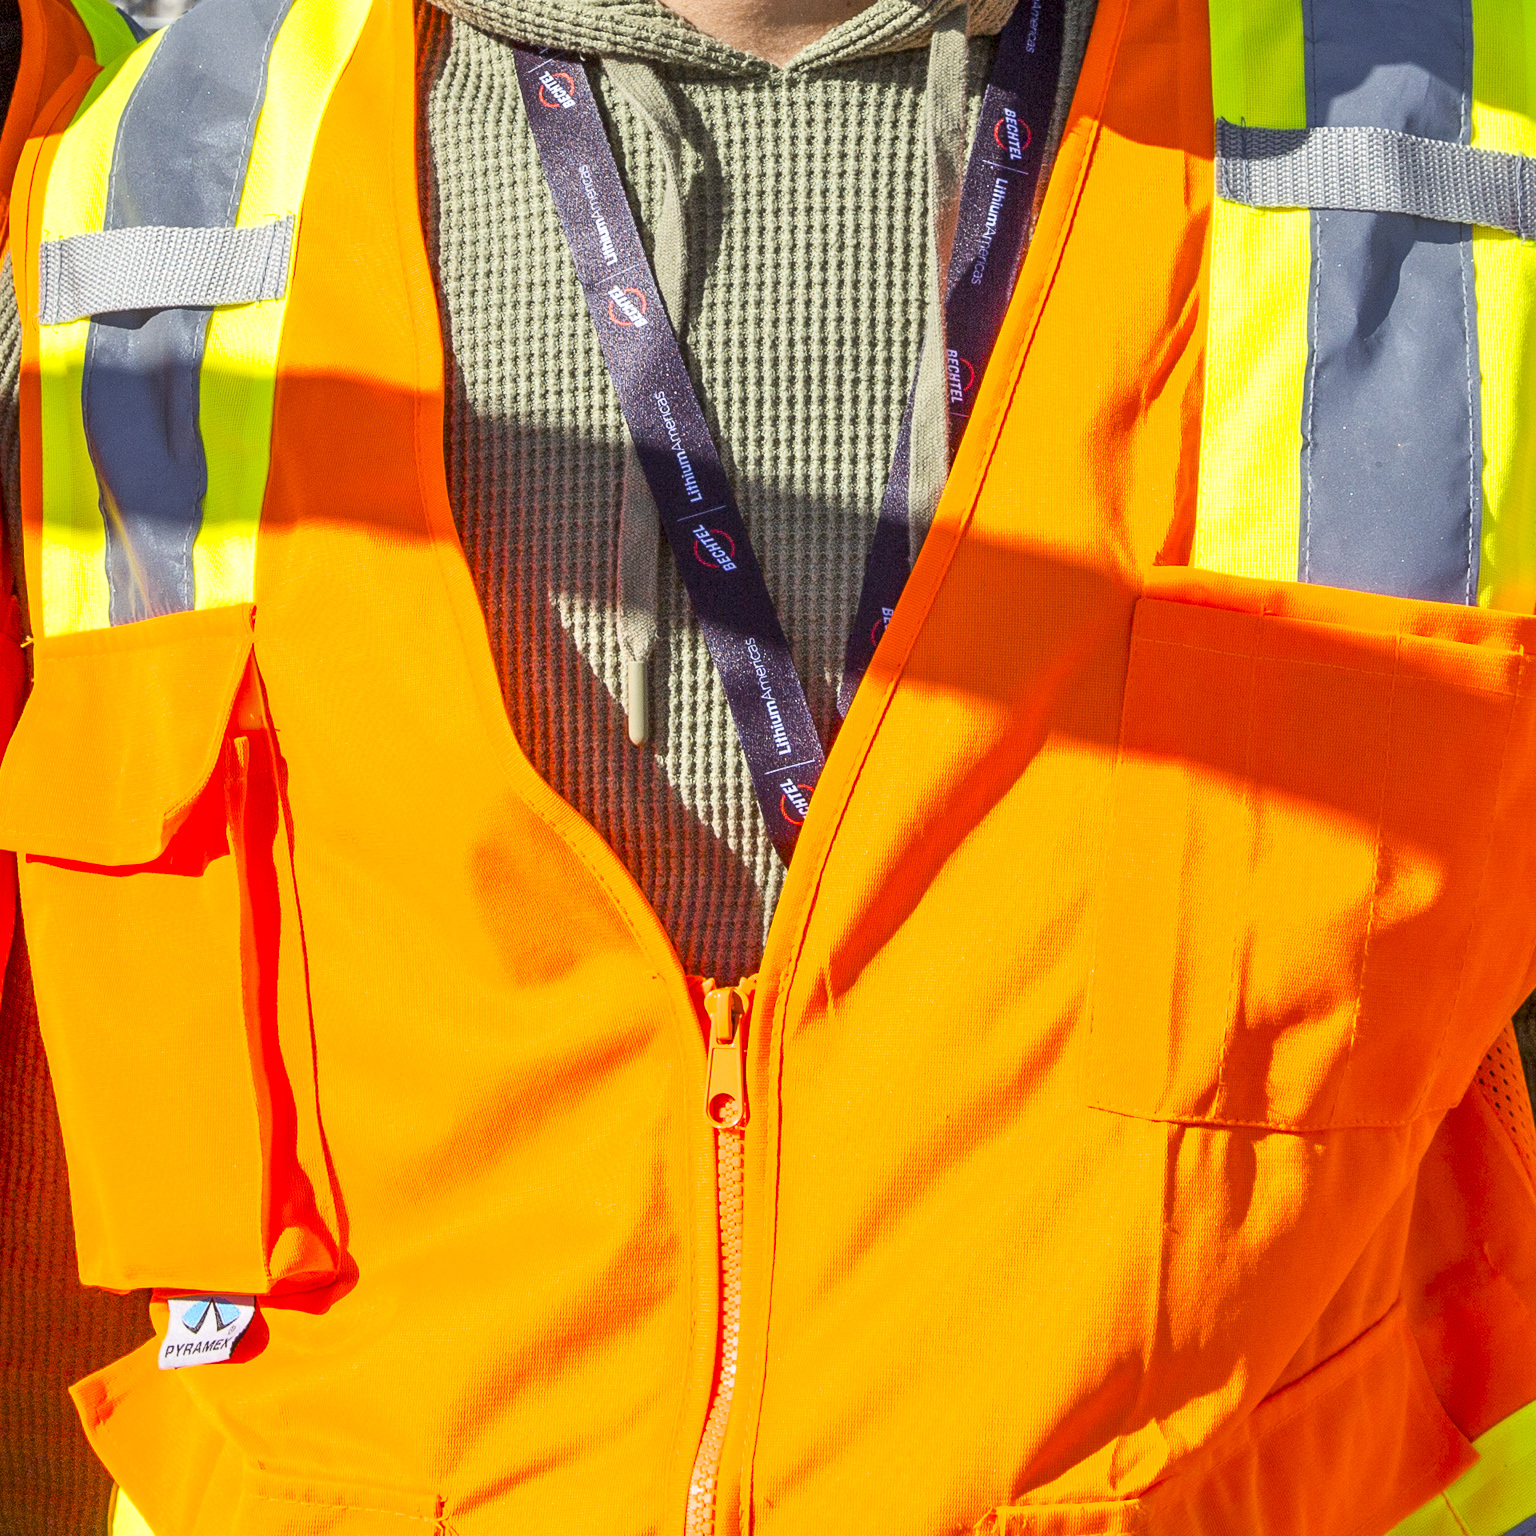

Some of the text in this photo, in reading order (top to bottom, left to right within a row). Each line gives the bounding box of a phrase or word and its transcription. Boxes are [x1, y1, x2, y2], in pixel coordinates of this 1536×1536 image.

[538, 70, 576, 109] BECHTEL
[1003, 107, 1023, 160] BECHTEL
[970, 177, 1009, 286] LithiumAmericas
[607, 284, 649, 329] BECHTEL
[946, 348, 964, 404] BECHTEL
[653, 390, 704, 504] LithiumAmericas
[691, 523, 738, 573] BECHTEL
[744, 636, 793, 756] LithiumAmericas
[779, 777, 810, 820] CHTEL
[164, 1336, 233, 1359] PYRAMEX
